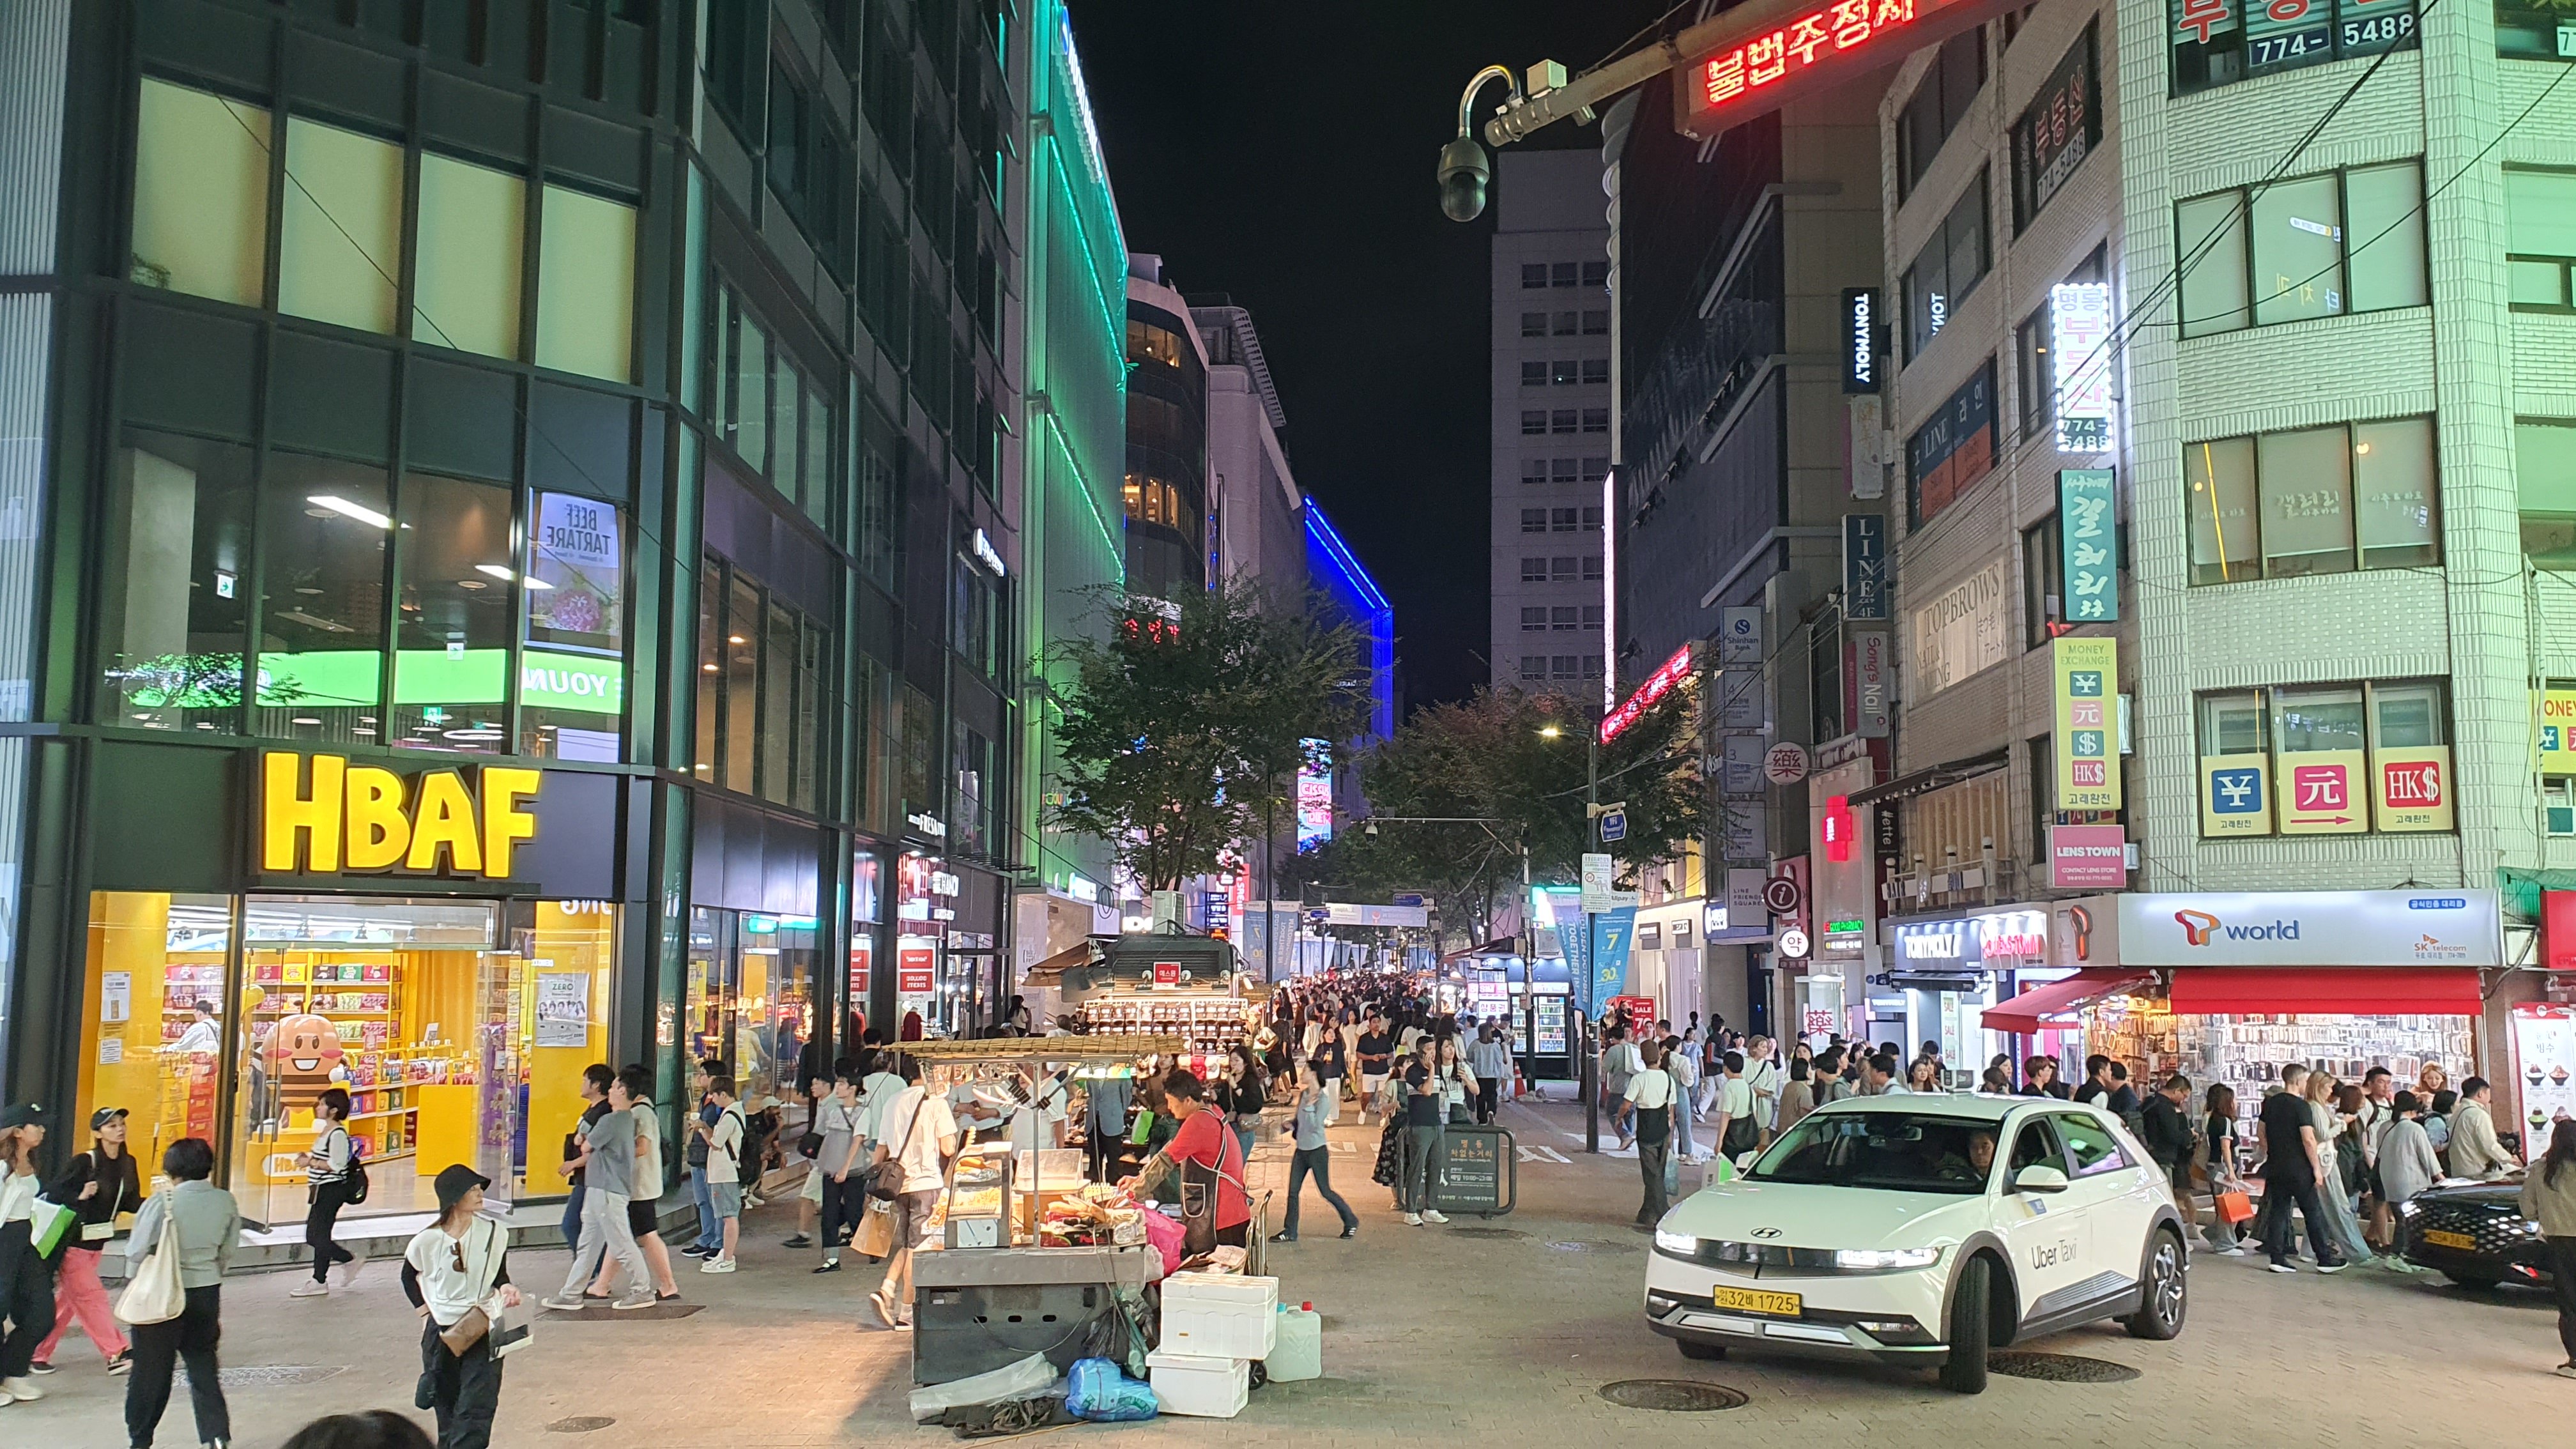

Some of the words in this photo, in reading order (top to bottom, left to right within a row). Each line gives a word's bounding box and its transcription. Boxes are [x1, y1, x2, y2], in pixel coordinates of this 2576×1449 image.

[2035, 65, 2084, 165] 부동산
[2038, 132, 2084, 203] 774-5488
[2059, 292, 2103, 311] 명동
[1854, 293, 1871, 383] TONYMOLY
[2063, 317, 2104, 410] 부동산
[1924, 417, 1947, 459] LINE
[1959, 381, 1982, 424] 라인
[1859, 518, 1875, 598] LINE
[1924, 565, 2001, 638] TOPBROWS
[1859, 608, 1874, 618] 4F
[1864, 637, 1882, 682] Song's
[2068, 645, 2104, 655] MONEY
[2060, 656, 2110, 666] EXCHANGE
[2073, 675, 2097, 693] ¥
[1864, 683, 1882, 716] Nail
[2075, 703, 2099, 724] 元
[2078, 732, 2097, 755] $
[1772, 749, 1802, 778] 藥
[2074, 763, 2104, 784] HK$
[2217, 774, 2252, 806] ¥
[2301, 770, 2341, 806] 元
[2388, 766, 2441, 802] HK$
[2068, 793, 2111, 805] 고래환전
[263, 753, 541, 878] HBAF
[2220, 820, 2251, 829] 고래환전
[2395, 815, 2431, 824] 고래환전
[1881, 809, 1894, 845] #ette
[2057, 847, 2085, 857] LENS
[2085, 847, 2121, 857] TOWN
[2441, 899, 2463, 908] 대리점
[1830, 921, 1841, 932] GOOD
[1841, 920, 1864, 931] PHARMACY
[2226, 919, 2300, 940] world
[1606, 933, 1619, 951] 7
[1787, 937, 1802, 953] 약
[1904, 933, 1959, 959] TONYMOLY
[2414, 943, 2428, 951] SK
[1600, 967, 1617, 982] 30
[1480, 1004, 1505, 1013] 상품권
[1944, 1001, 1954, 1012] SALE
[1805, 1009, 1833, 1036] 藥
[1945, 1025, 1954, 1036] SALE
[1945, 1048, 1956, 1059] SALE
[2534, 1043, 2553, 1053] 빙수
[274, 1158, 306, 1174] HBA
[2032, 1245, 2057, 1269] Uber
[2058, 1237, 2077, 1262] Taxi
[1728, 1291, 1754, 1307] 32바
[1758, 1294, 1795, 1312] 1725
